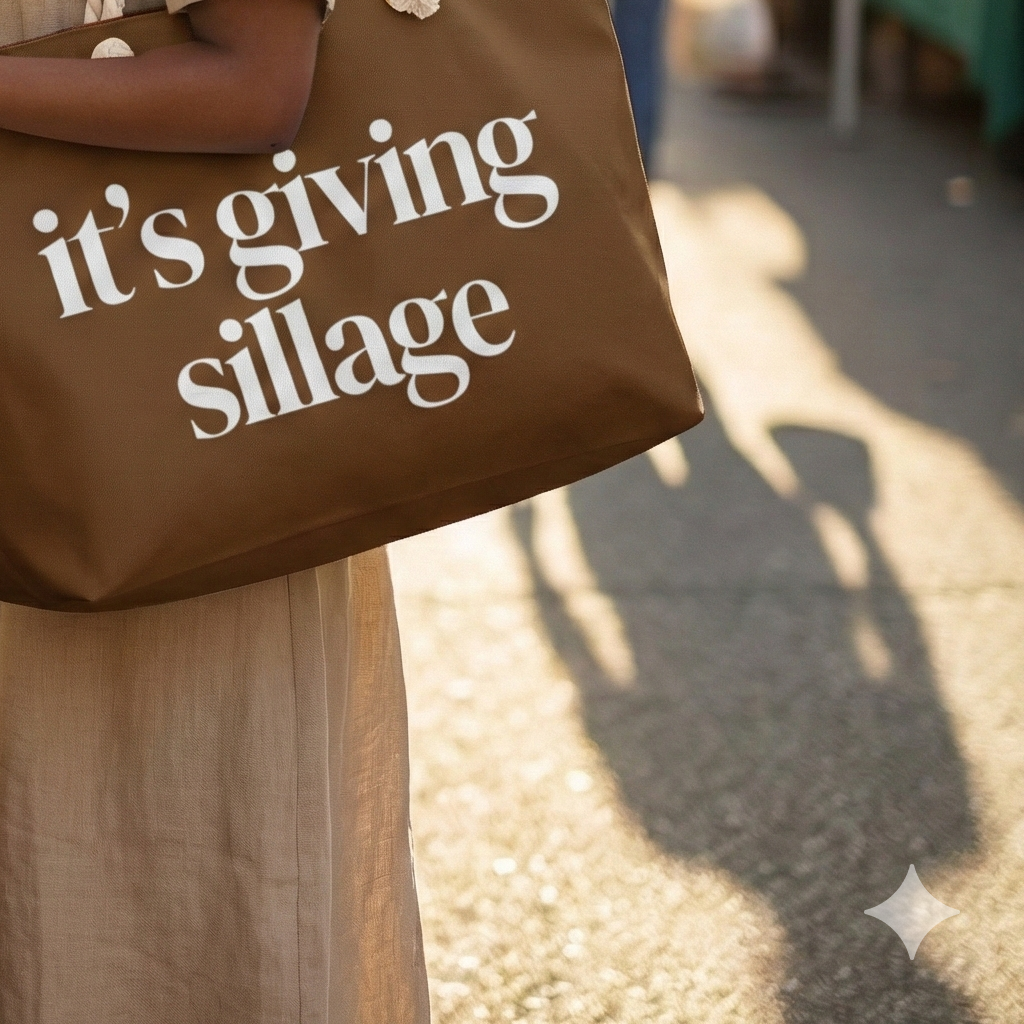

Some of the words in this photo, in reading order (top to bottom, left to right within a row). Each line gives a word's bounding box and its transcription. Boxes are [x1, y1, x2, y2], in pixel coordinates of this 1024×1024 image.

[32, 184, 205, 319] it's
[216, 109, 560, 301] giving
[177, 279, 516, 440] sillage
